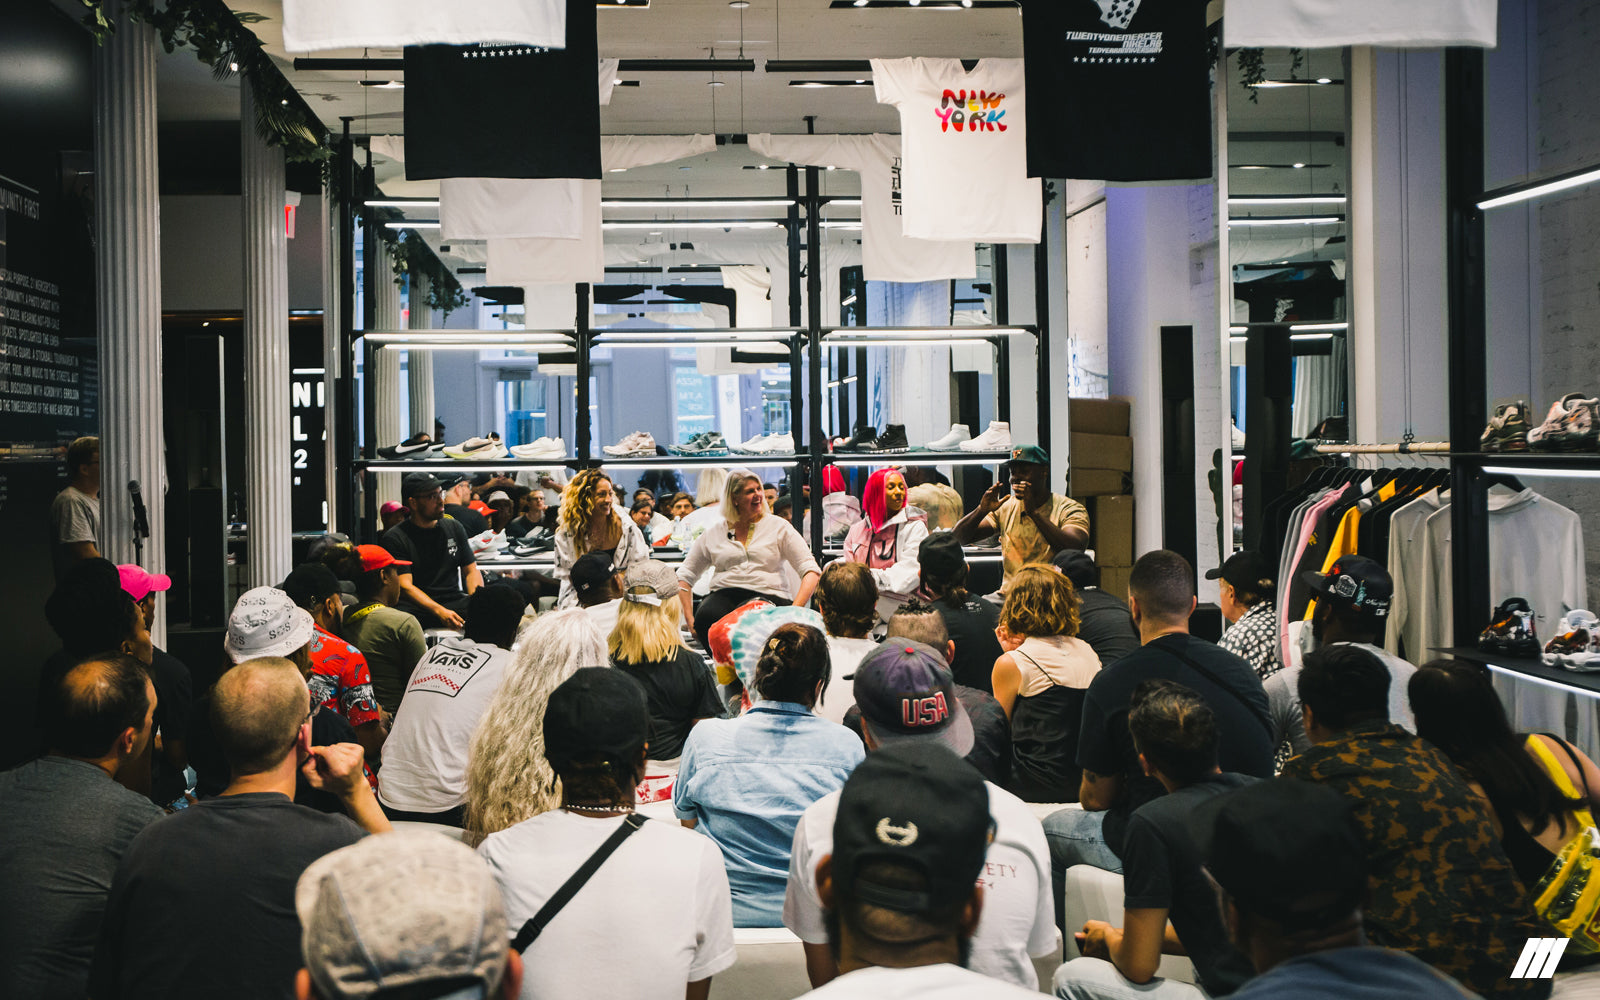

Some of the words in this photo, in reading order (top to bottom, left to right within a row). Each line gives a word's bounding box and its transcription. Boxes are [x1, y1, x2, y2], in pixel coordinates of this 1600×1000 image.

[941, 89, 1006, 111] NEW
[935, 107, 1008, 133] YORK
[429, 649, 478, 669] VANS
[902, 691, 949, 727] USA
